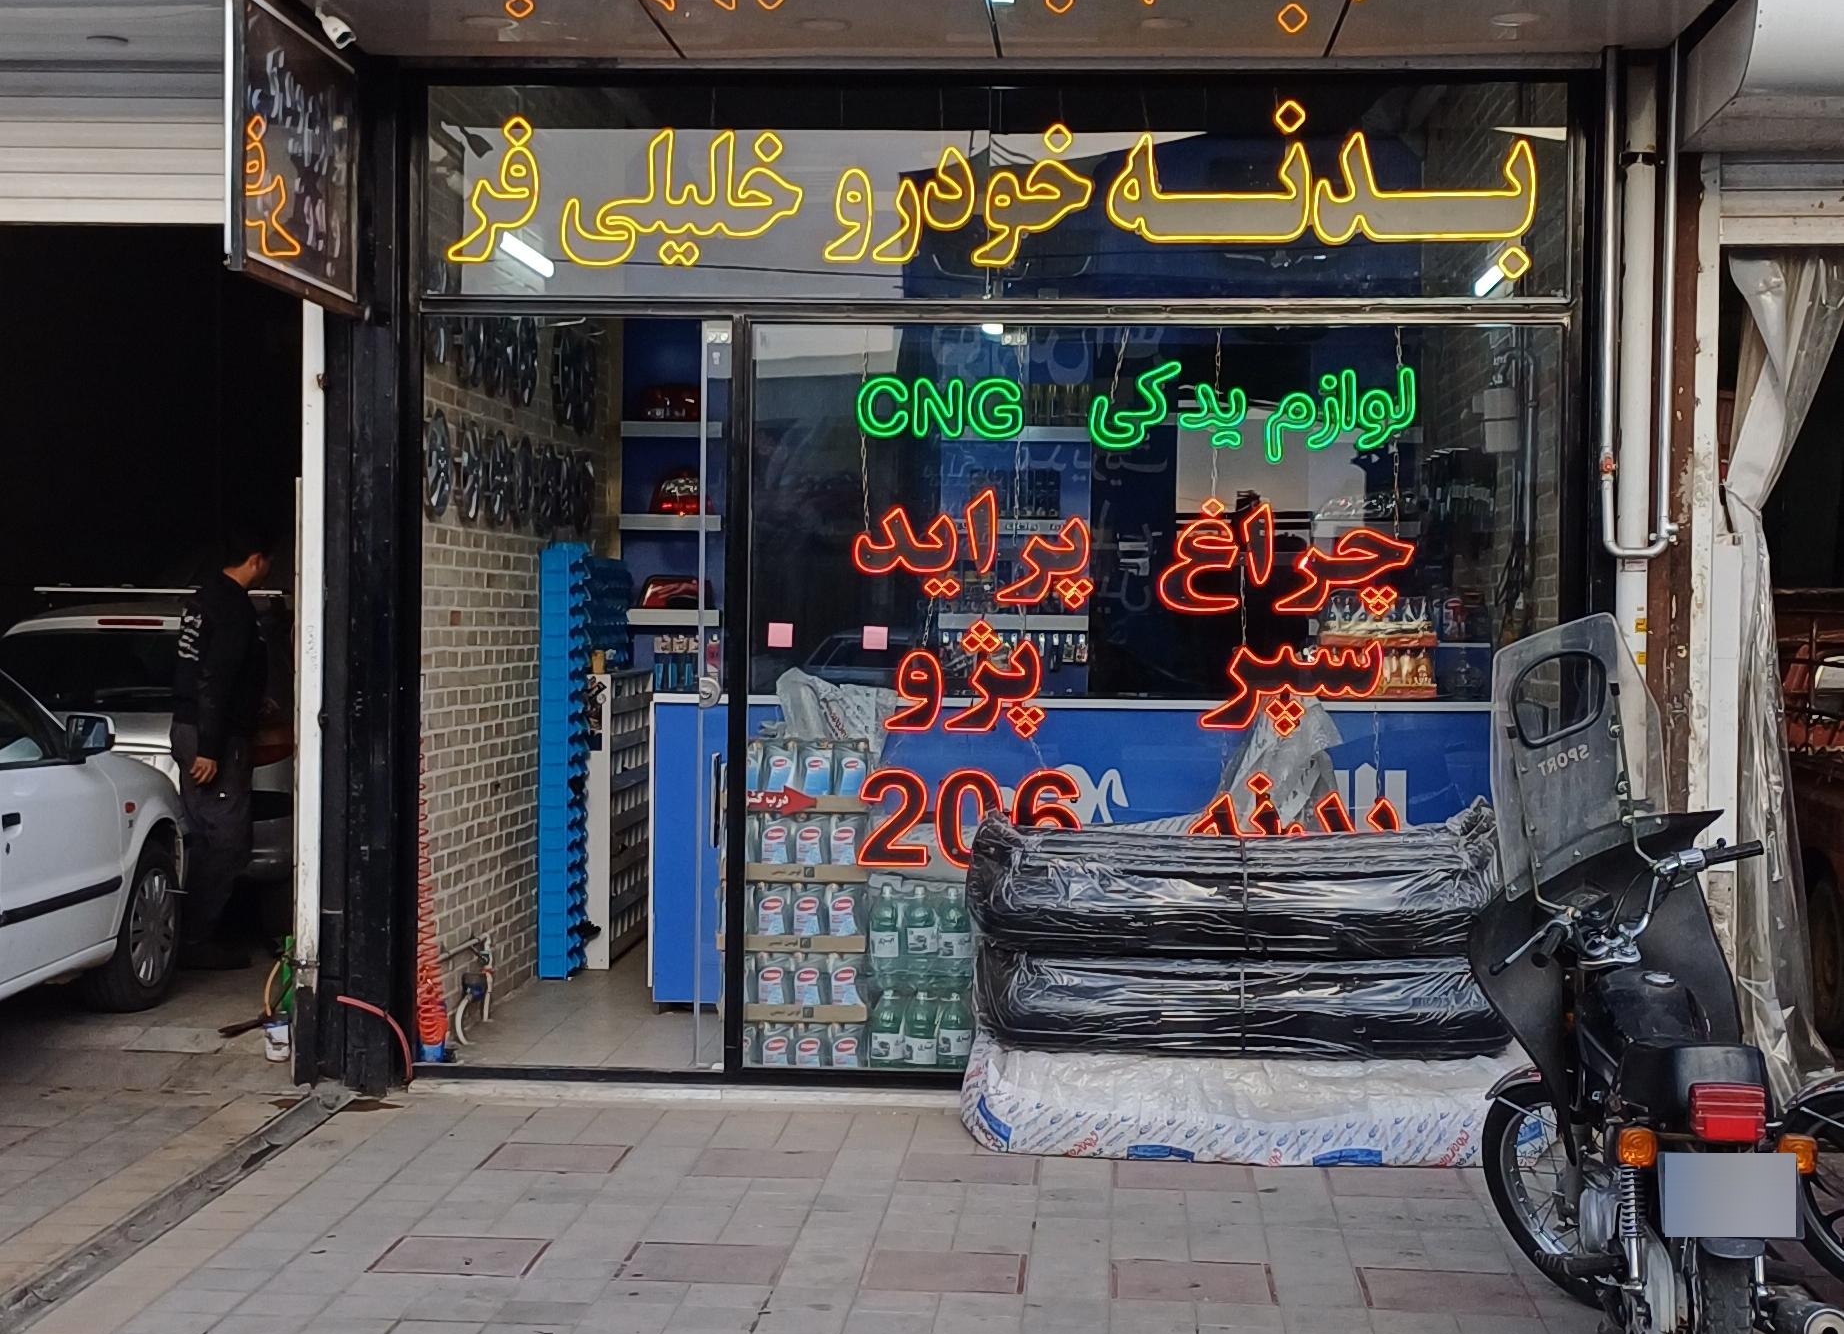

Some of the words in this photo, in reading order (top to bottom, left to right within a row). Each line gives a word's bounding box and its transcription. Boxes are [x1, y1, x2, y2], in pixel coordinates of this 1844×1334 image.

[447, 115, 541, 263] فر
[560, 127, 803, 268] خلیلی
[823, 122, 1094, 267] خودرو
[1106, 99, 1538, 280] بدنه
[856, 375, 1025, 440] CNG
[1264, 365, 1417, 464] لوازم
[853, 488, 1095, 612] پراید
[1157, 497, 1416, 615] چراغ
[884, 618, 1043, 740] پژو
[1199, 641, 1384, 738] سپر
[765, 794, 789, 808] درب
[857, 767, 1084, 868] 206
